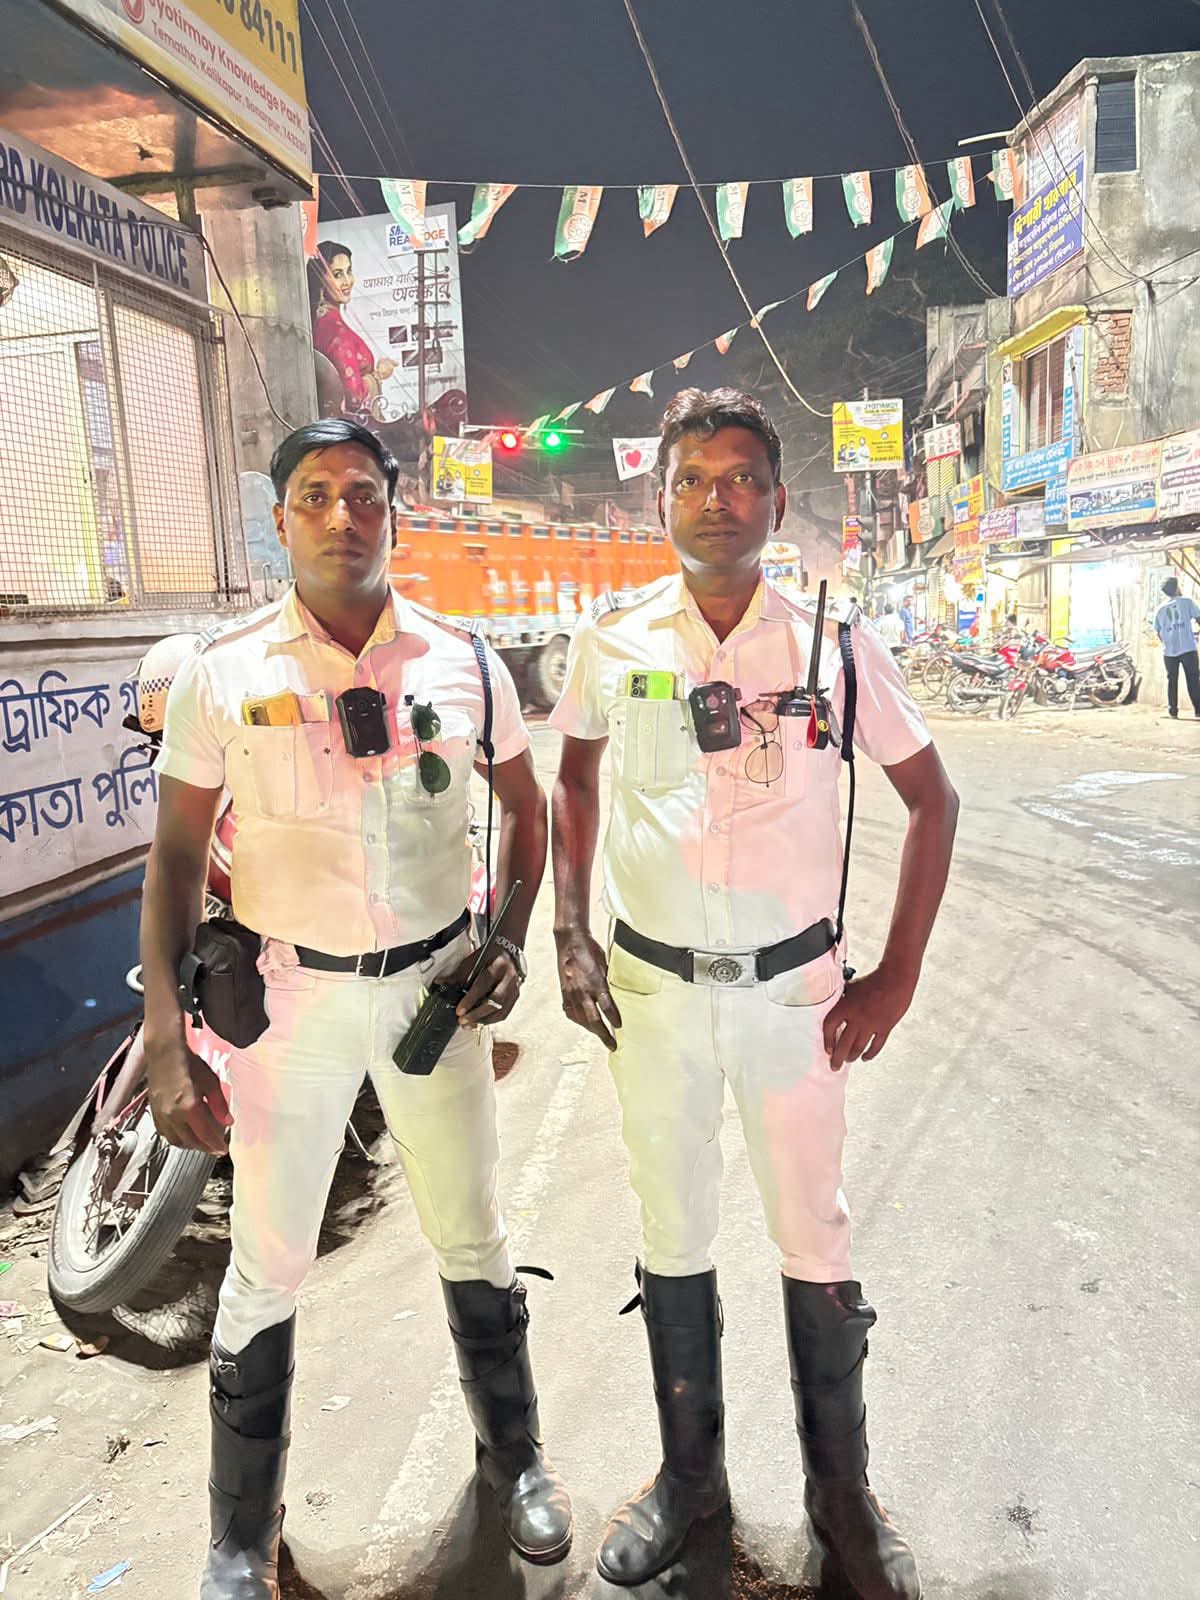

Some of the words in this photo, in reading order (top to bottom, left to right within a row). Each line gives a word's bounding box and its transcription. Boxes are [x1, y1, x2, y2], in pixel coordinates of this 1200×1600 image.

[148, 0, 216, 62] yotirmoy
[218, 46, 280, 112] Knowledge
[30, 158, 126, 261] KOLKATA
[127, 207, 190, 290] POLICE
[92, 746, 158, 828] পুলি
